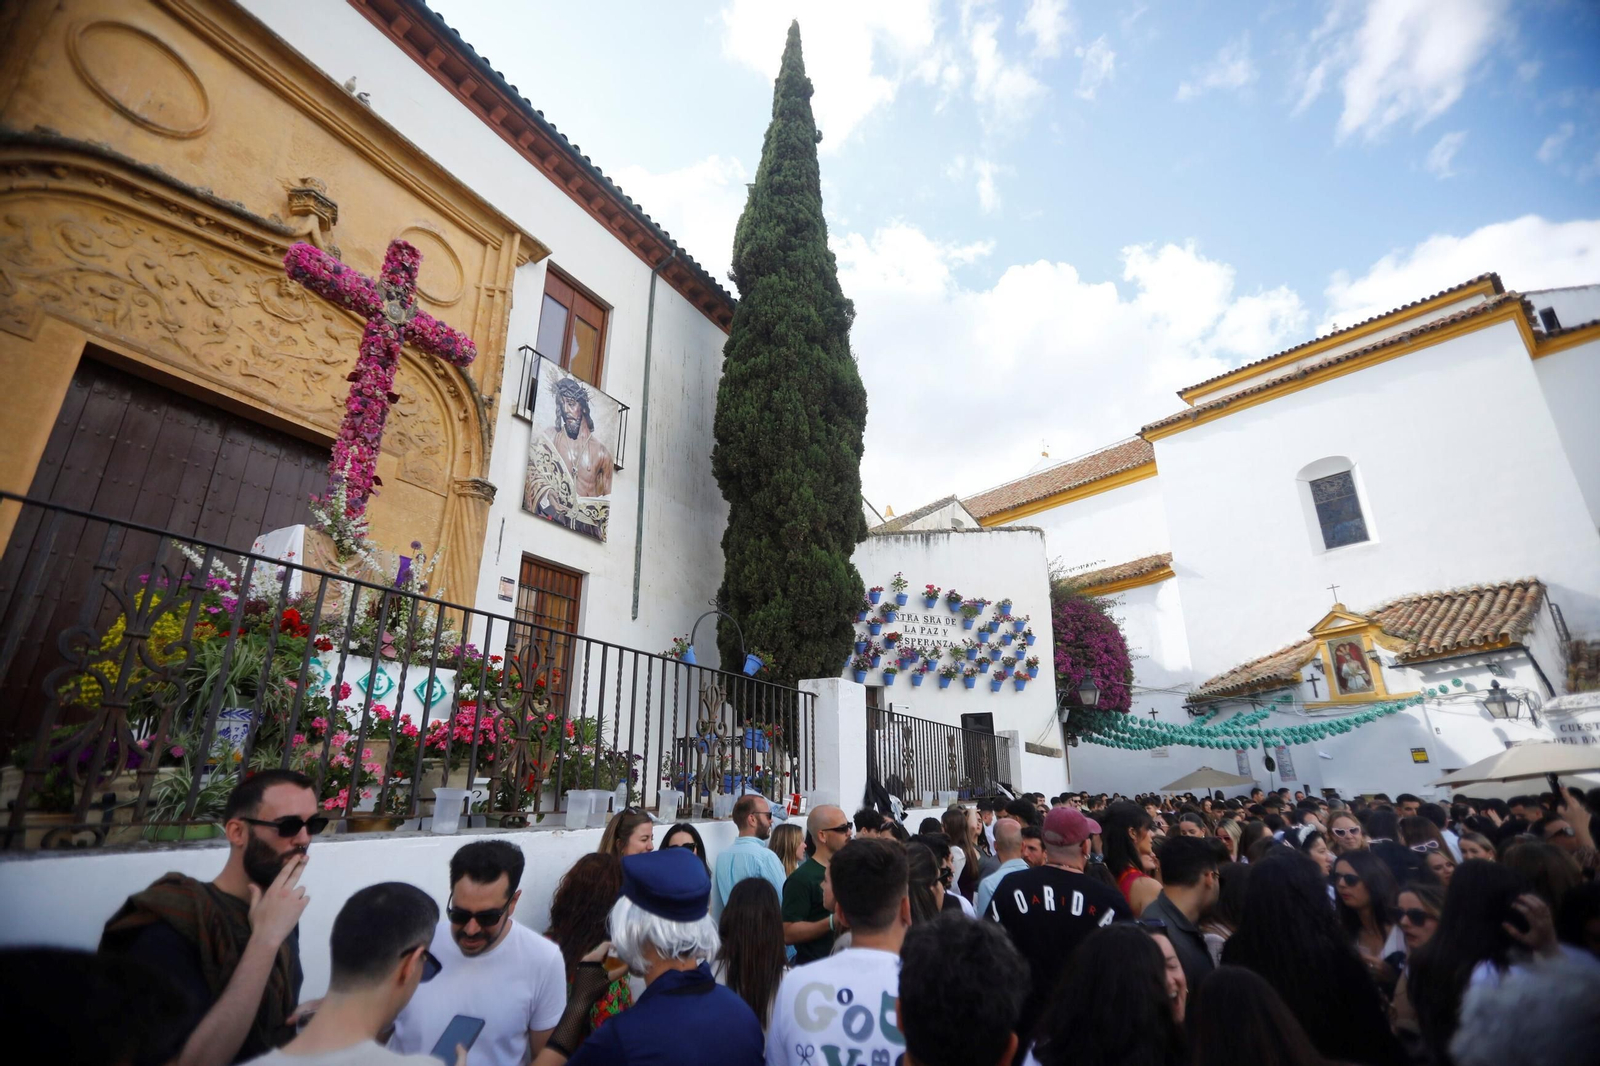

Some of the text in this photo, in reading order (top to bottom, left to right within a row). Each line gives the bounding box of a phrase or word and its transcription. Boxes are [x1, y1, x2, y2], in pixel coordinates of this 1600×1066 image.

[923, 615, 942, 624] SRA
[945, 617, 957, 626] DE
[904, 625, 949, 636] LA PAZ Y
